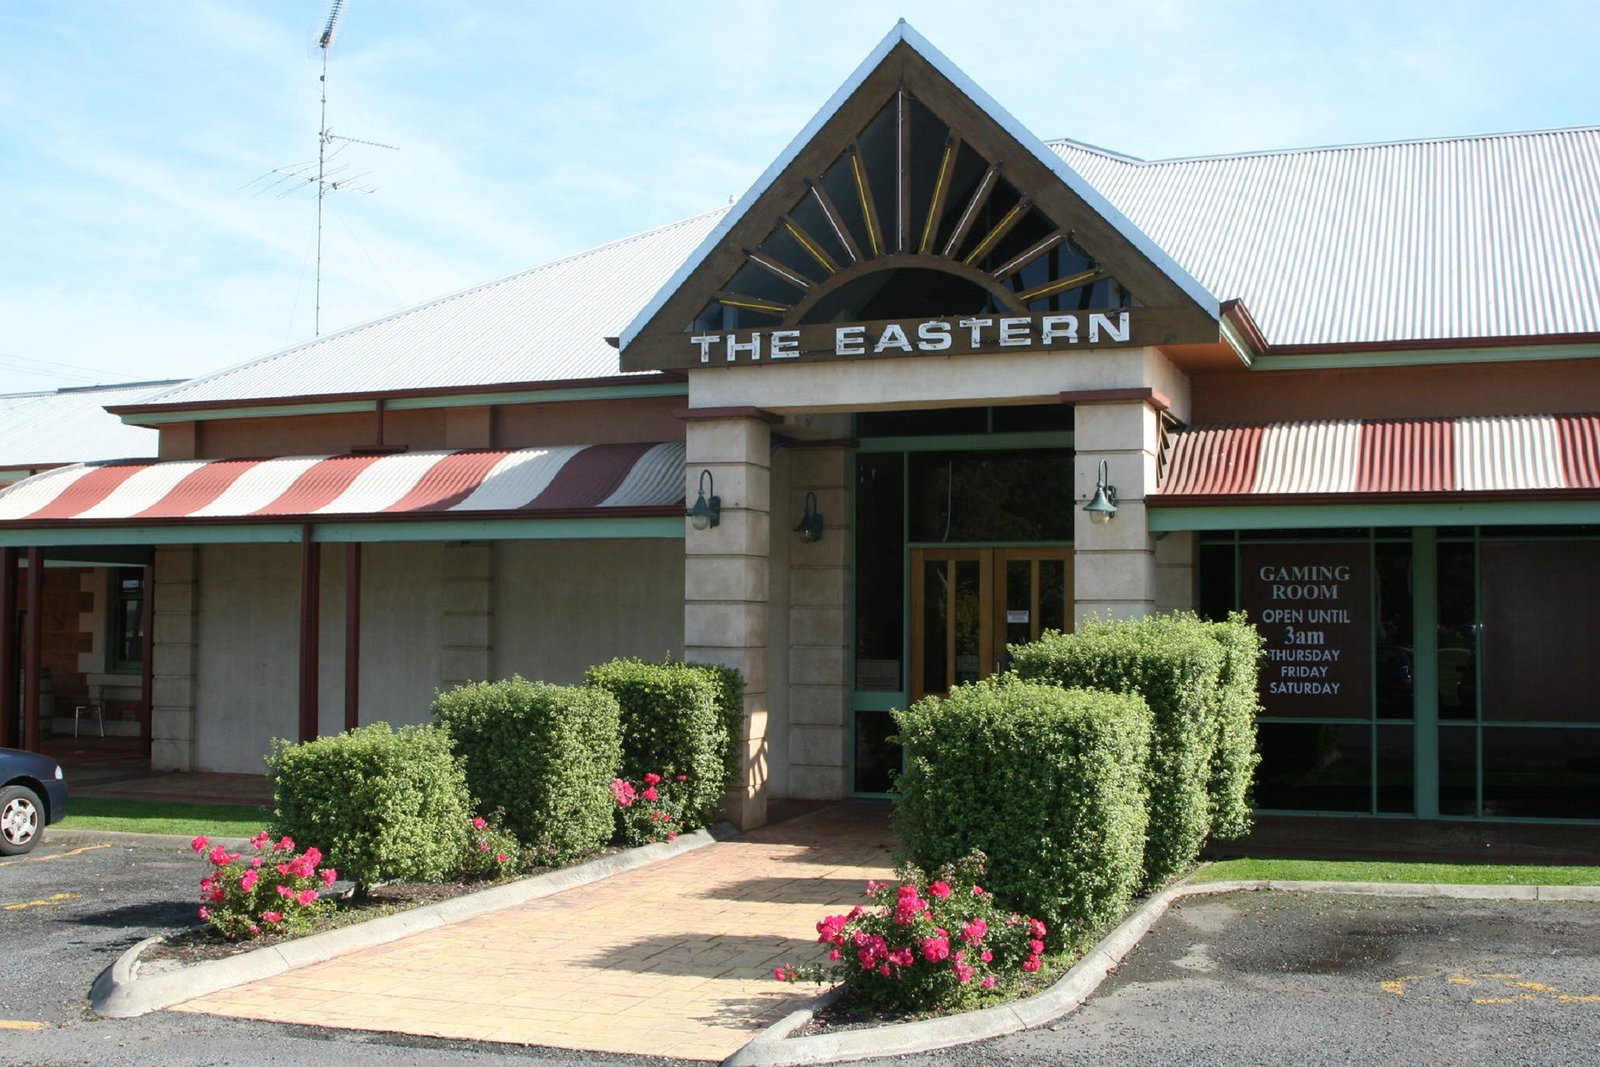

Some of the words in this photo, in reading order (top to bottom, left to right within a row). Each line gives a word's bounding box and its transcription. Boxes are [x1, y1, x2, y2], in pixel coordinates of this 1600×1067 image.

[691, 330, 800, 363] THE
[835, 312, 1130, 356] EASTERN
[1259, 565, 1350, 582] GAMING
[1271, 584, 1339, 600] ROOM
[1262, 609, 1303, 623] OPEN
[1308, 609, 1350, 623] UNTIL
[1283, 625, 1325, 645] 3am
[1269, 649, 1341, 662] THURSDAY
[1281, 665, 1328, 678] FRIDAY
[1269, 681, 1341, 695] SATURDAY
